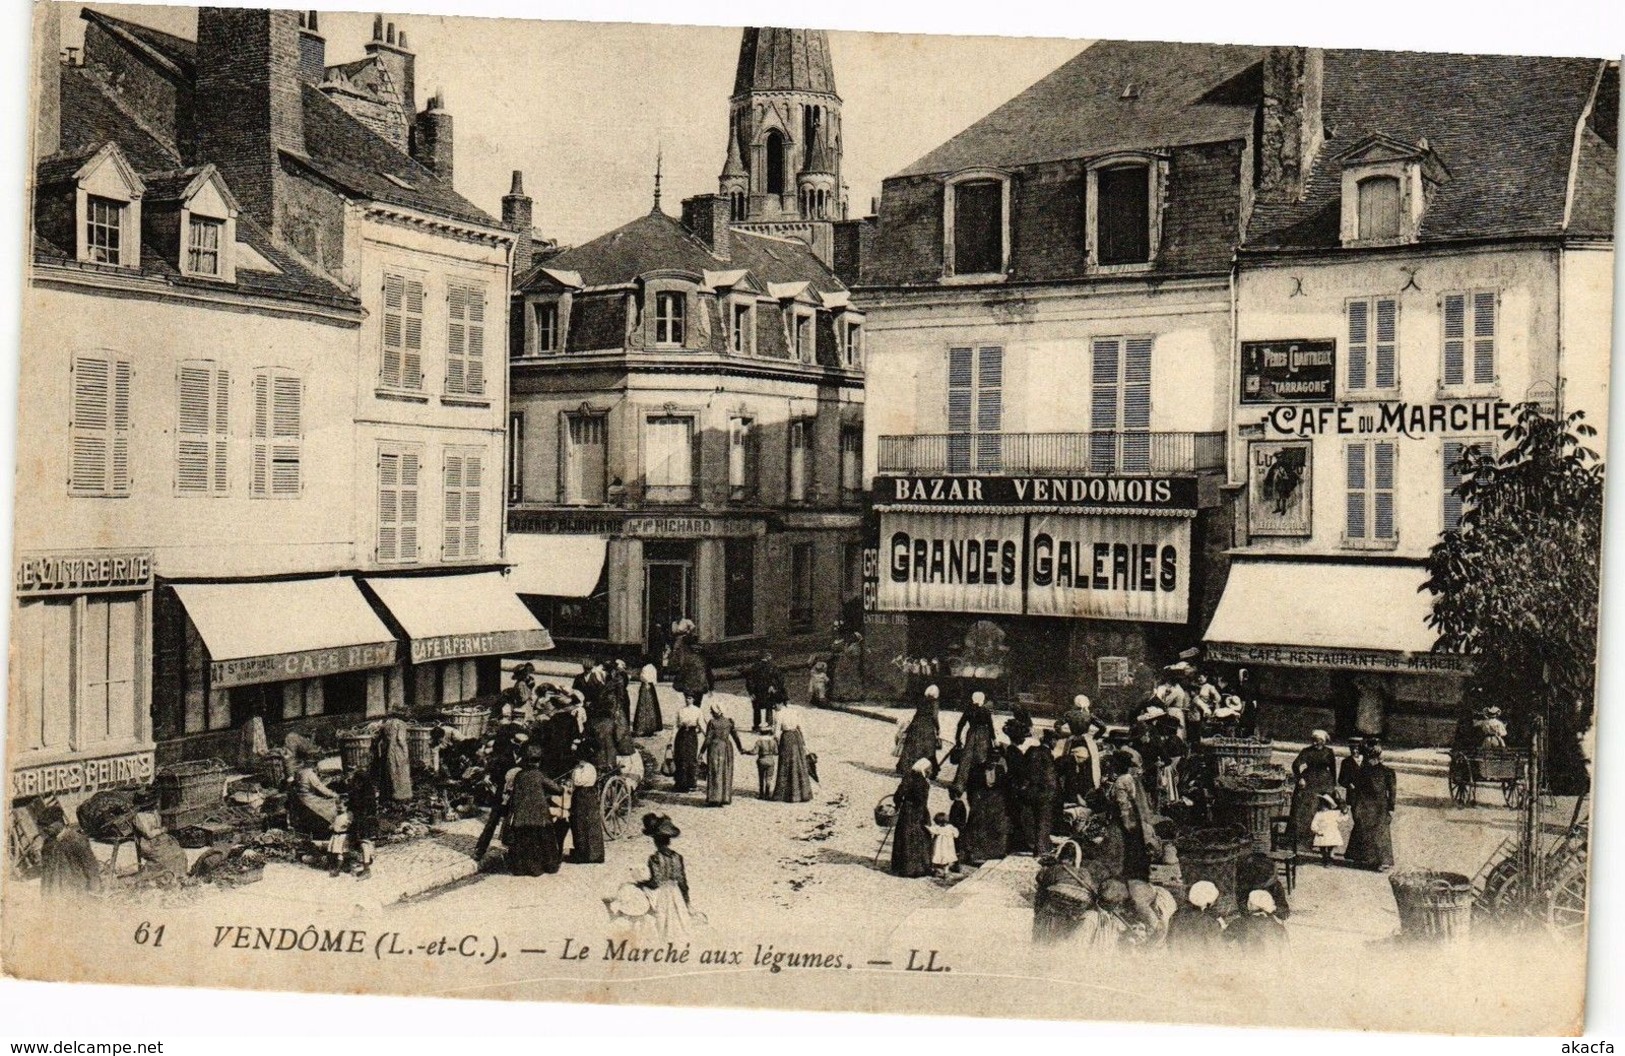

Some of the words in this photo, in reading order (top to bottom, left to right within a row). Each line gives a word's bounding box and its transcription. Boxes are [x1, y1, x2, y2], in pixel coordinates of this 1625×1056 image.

[1268, 404, 1354, 439] CAFÉ
[1360, 416, 1374, 433] DU
[1379, 399, 1512, 440] MARCHÉ
[894, 478, 984, 500] BAZAR
[1012, 478, 1171, 502] VENDOMOIS
[655, 518, 711, 534] RICHARD
[38, 557, 149, 585] VITRERIE
[890, 531, 1016, 586] GRANDES
[1032, 533, 1177, 593] GALERIES
[1289, 650, 1378, 666] RESTAURANT
